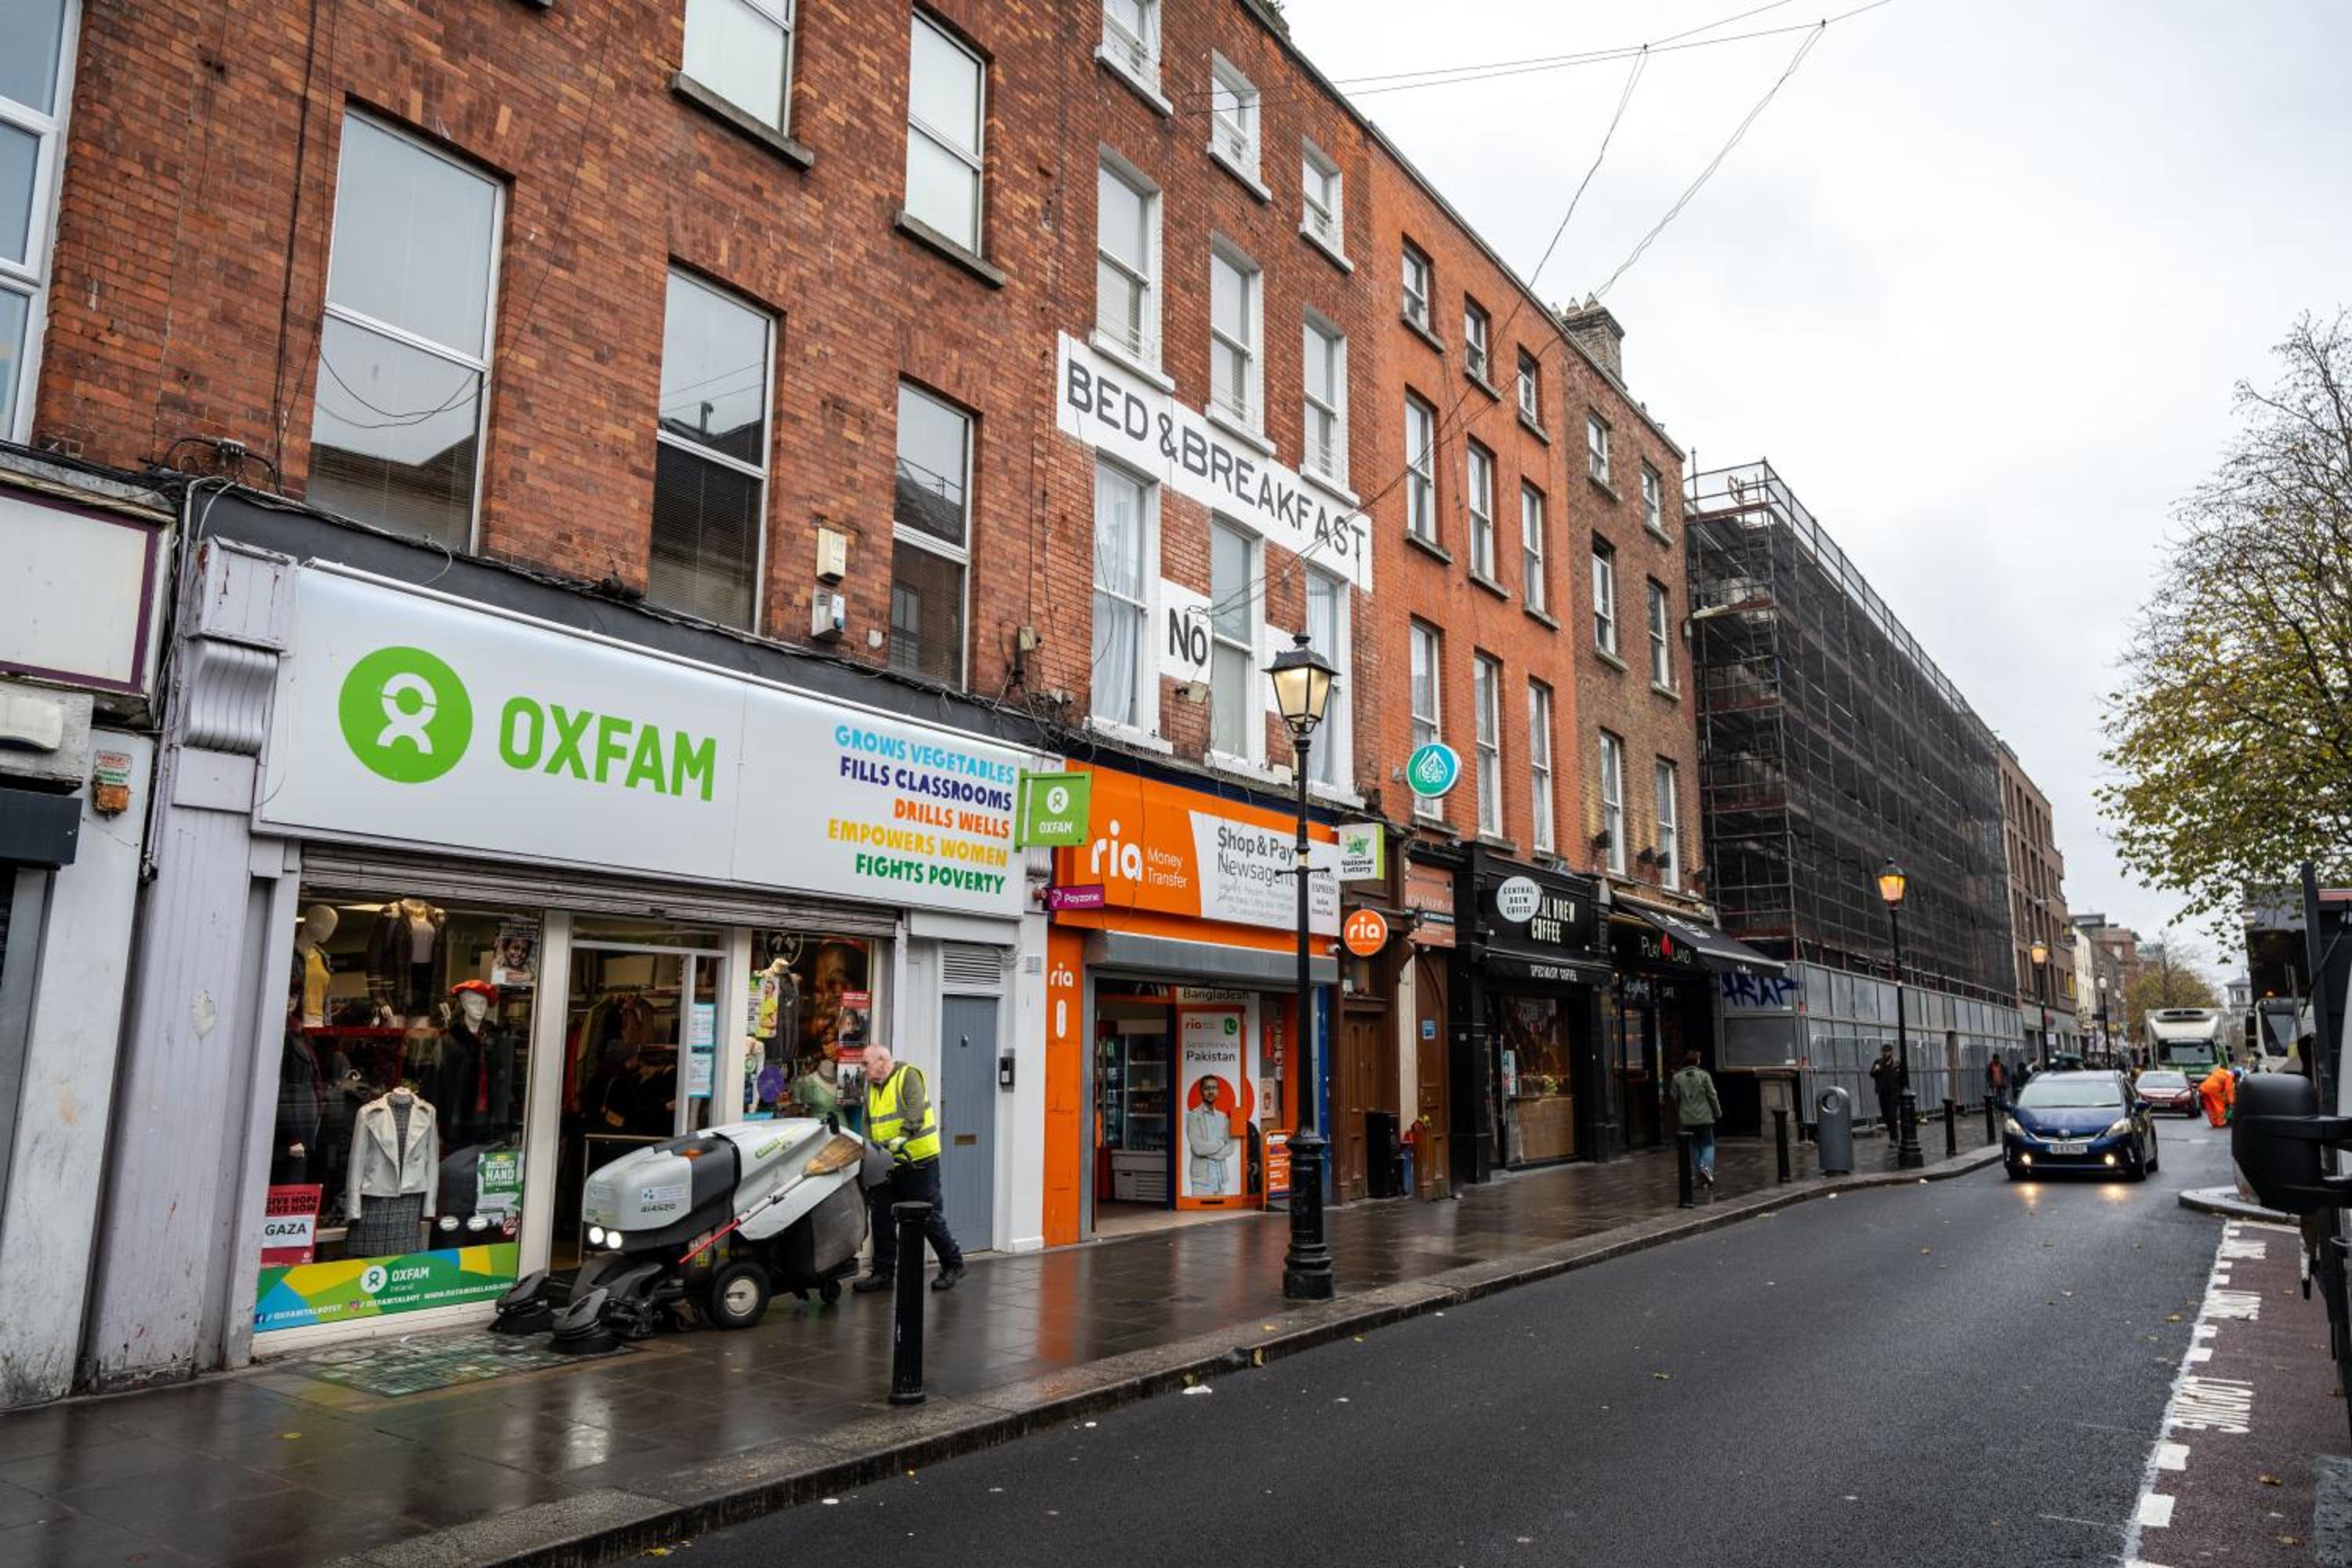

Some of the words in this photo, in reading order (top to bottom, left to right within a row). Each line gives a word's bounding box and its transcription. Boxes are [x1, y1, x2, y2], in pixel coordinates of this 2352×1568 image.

[1067, 358, 1149, 441] BED
[1158, 412, 1178, 463] &
[1183, 426, 1366, 560] BREAKFAST
[498, 696, 717, 801] OXFAM
[835, 726, 907, 760] GROWS
[909, 744, 1015, 786] VEGETABLES
[840, 756, 890, 786] FILLS
[895, 769, 1012, 811] CLASSROOMS
[894, 798, 953, 829] DRILLS
[958, 813, 1010, 840] WELLS
[1039, 821, 1073, 835] OXFAM
[828, 818, 935, 856] EMPOWERS
[941, 839, 1008, 868] WOMEN
[1091, 819, 1142, 882] ria
[1217, 826, 1254, 858] Shop
[1257, 835, 1268, 857] &
[1270, 837, 1294, 866] Pay
[1146, 846, 1183, 873] Money
[1341, 858, 1374, 867] National
[1343, 866, 1372, 874] Lottery
[855, 853, 924, 884] FIGHTS
[929, 865, 1005, 895] POVERTY
[1147, 866, 1188, 888] Transfer
[1064, 894, 1100, 904] Payzone
[1348, 916, 1381, 940] ria
[1531, 917, 1561, 943] COFFEE
[1050, 963, 1074, 987] ria
[1183, 988, 1249, 1001] Bangladesh
[1186, 1051, 1236, 1062] Pakistan
[485, 1169, 515, 1181] HAND
[264, 1223, 307, 1236] GAZA
[392, 1266, 430, 1282] OXFAM
